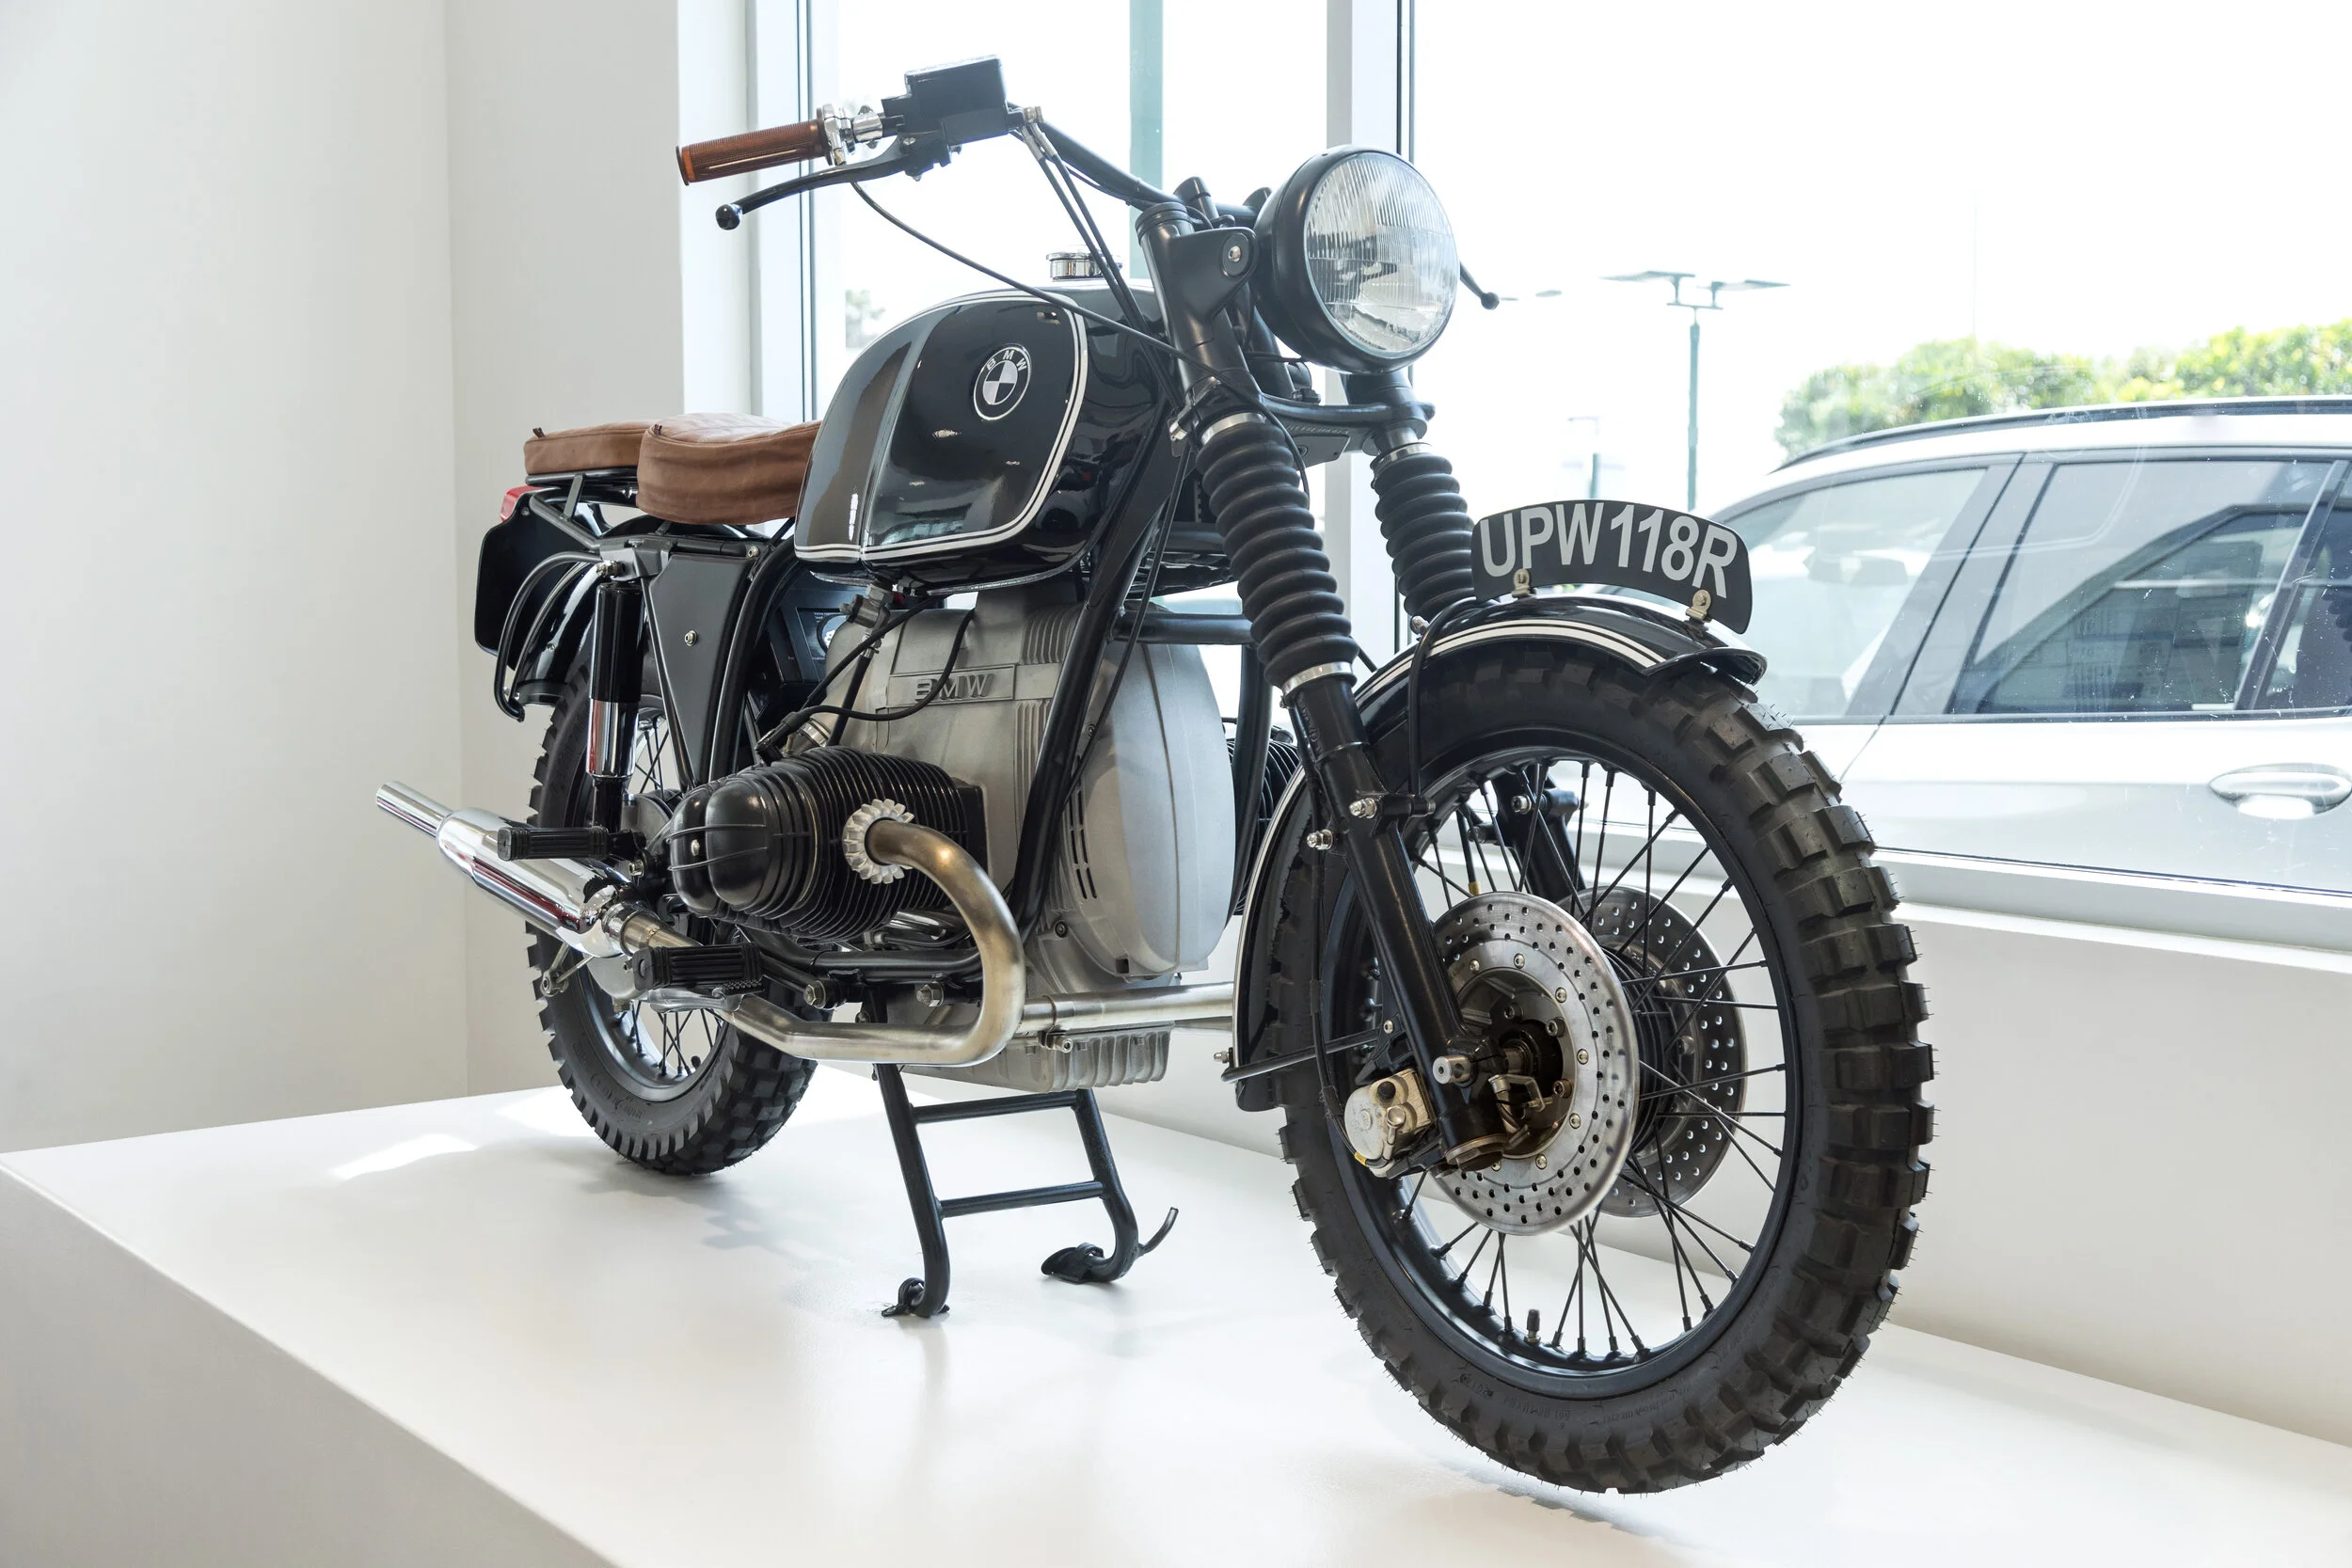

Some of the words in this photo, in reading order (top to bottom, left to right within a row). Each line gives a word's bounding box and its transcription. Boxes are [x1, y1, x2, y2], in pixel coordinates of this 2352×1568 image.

[986, 350, 1027, 372] BMW
[1480, 502, 1738, 599] UPW118R
[915, 674, 993, 702] BMW
